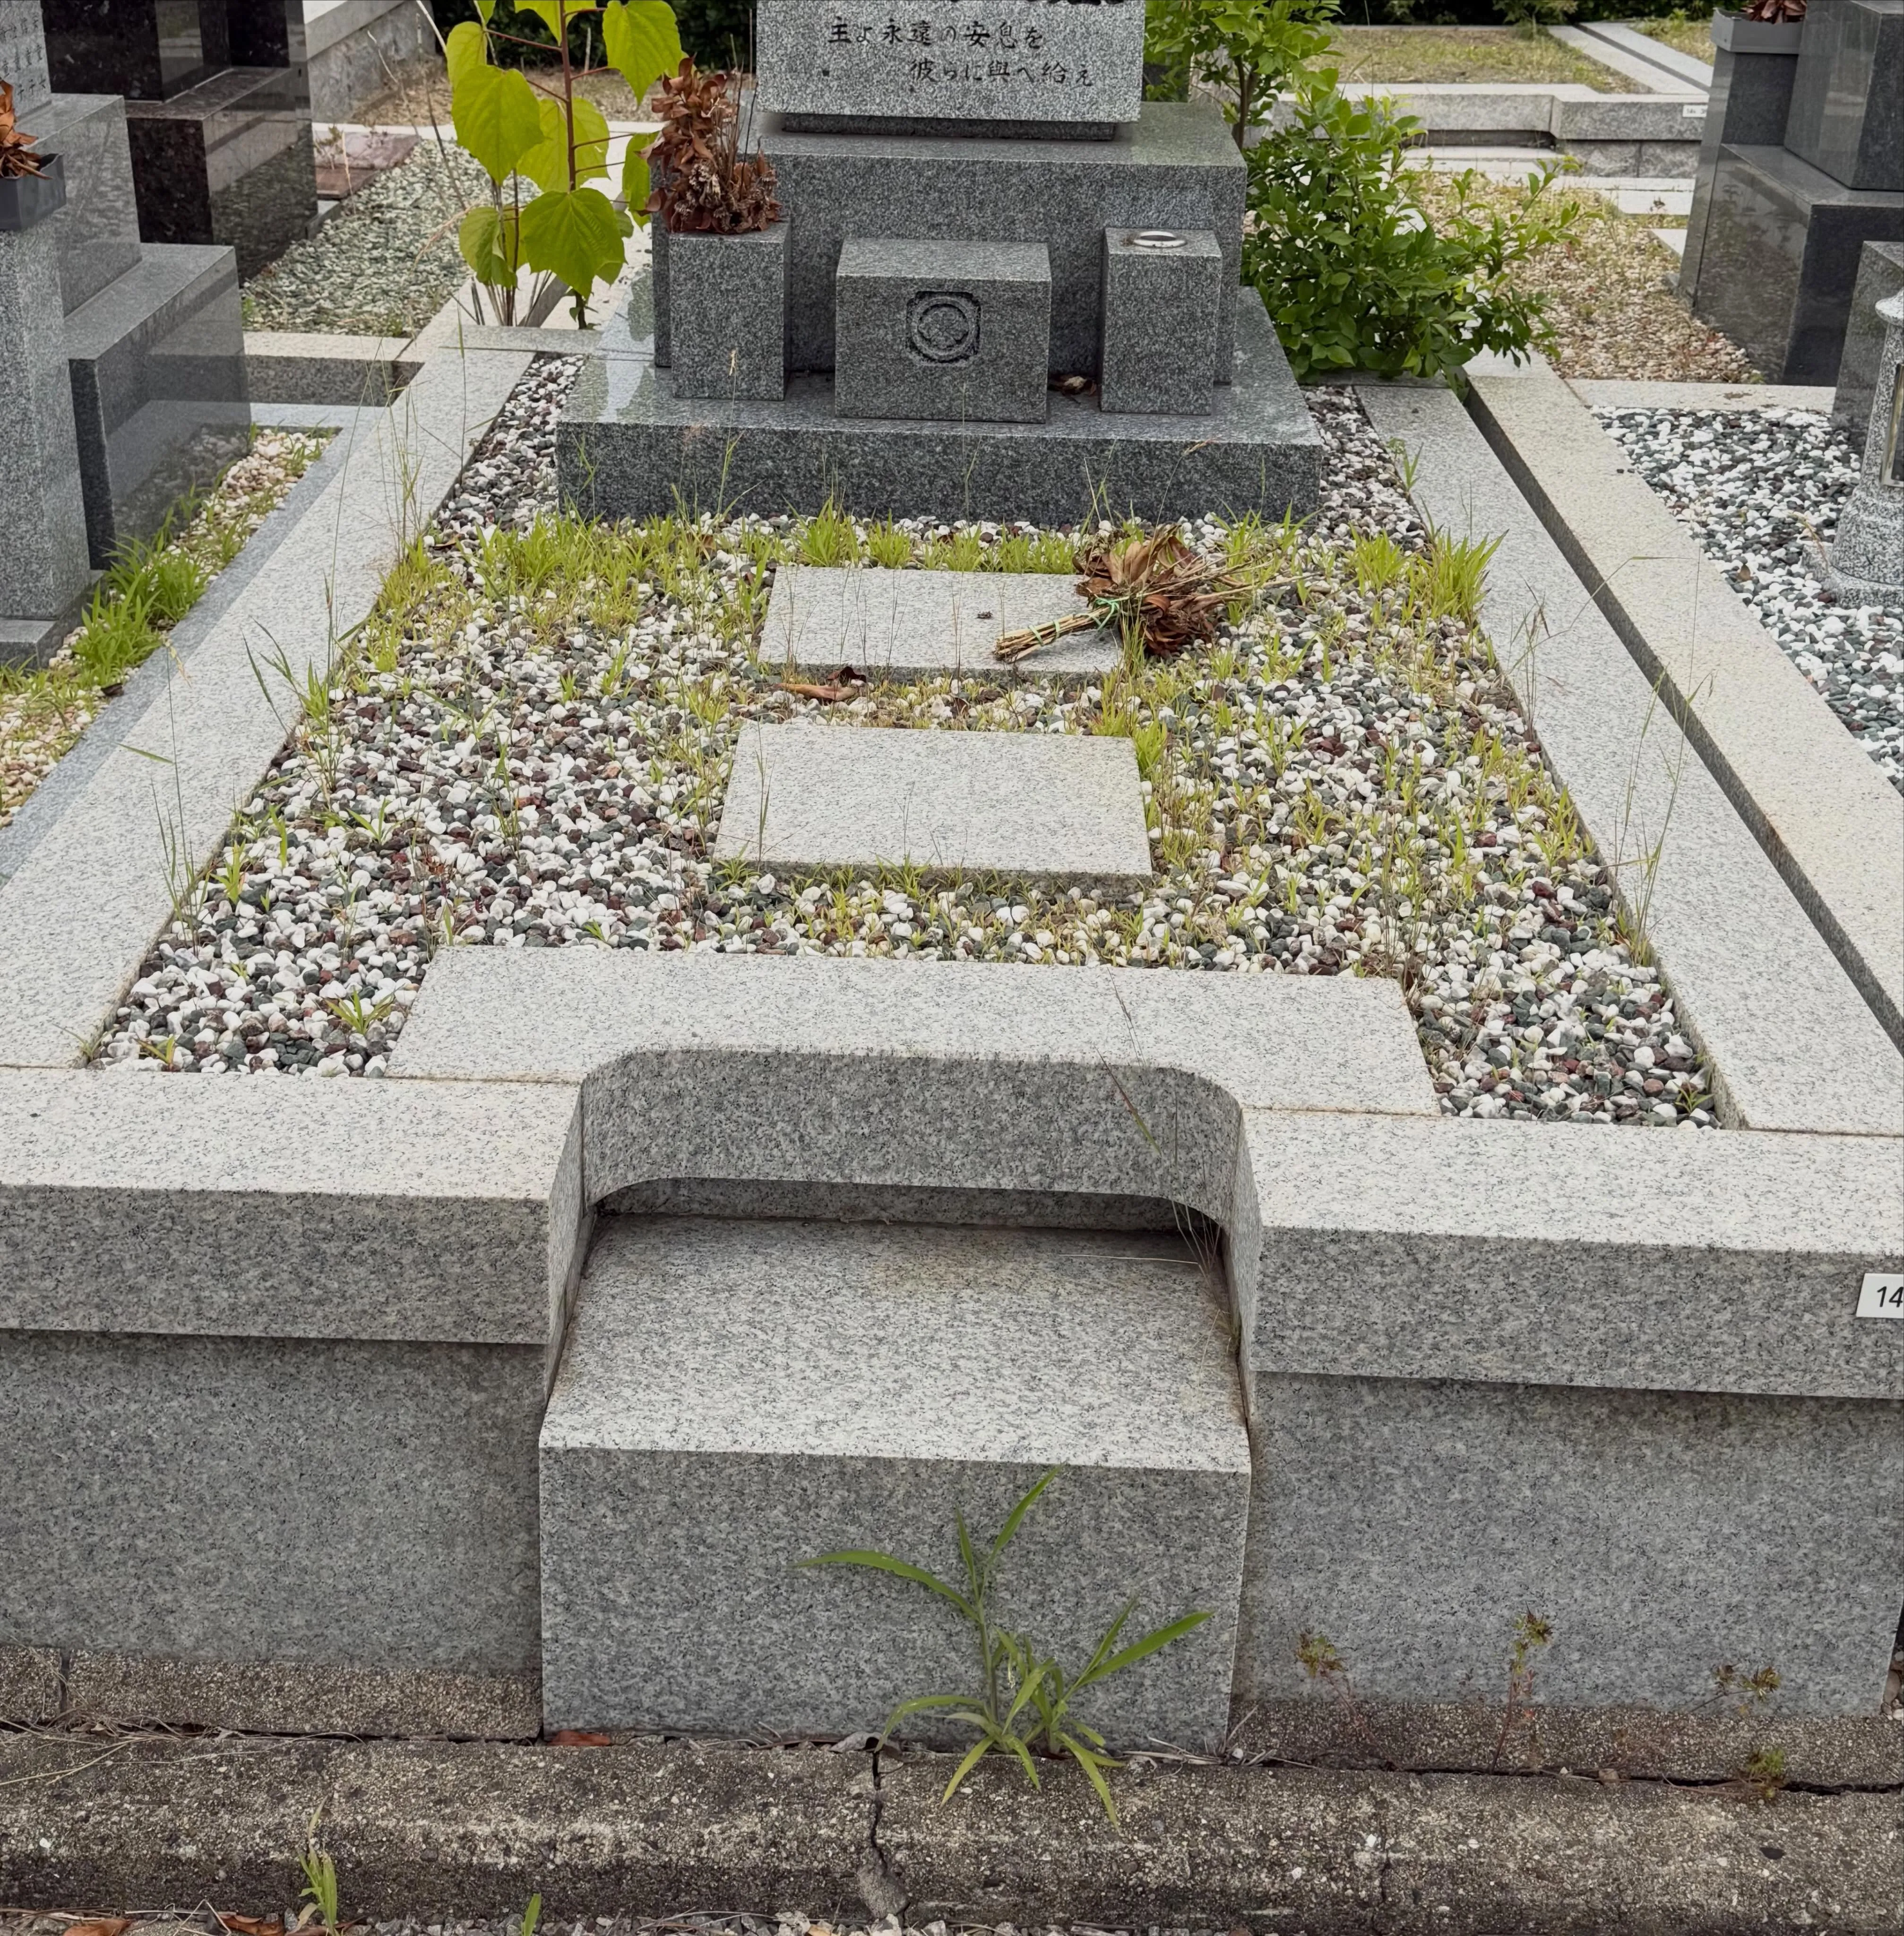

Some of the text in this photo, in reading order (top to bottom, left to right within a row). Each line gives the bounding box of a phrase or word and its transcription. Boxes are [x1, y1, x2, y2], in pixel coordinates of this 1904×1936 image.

[828, 16, 1043, 49] 主よ永遠の安息を
[1877, 1286, 1904, 1308] 14
